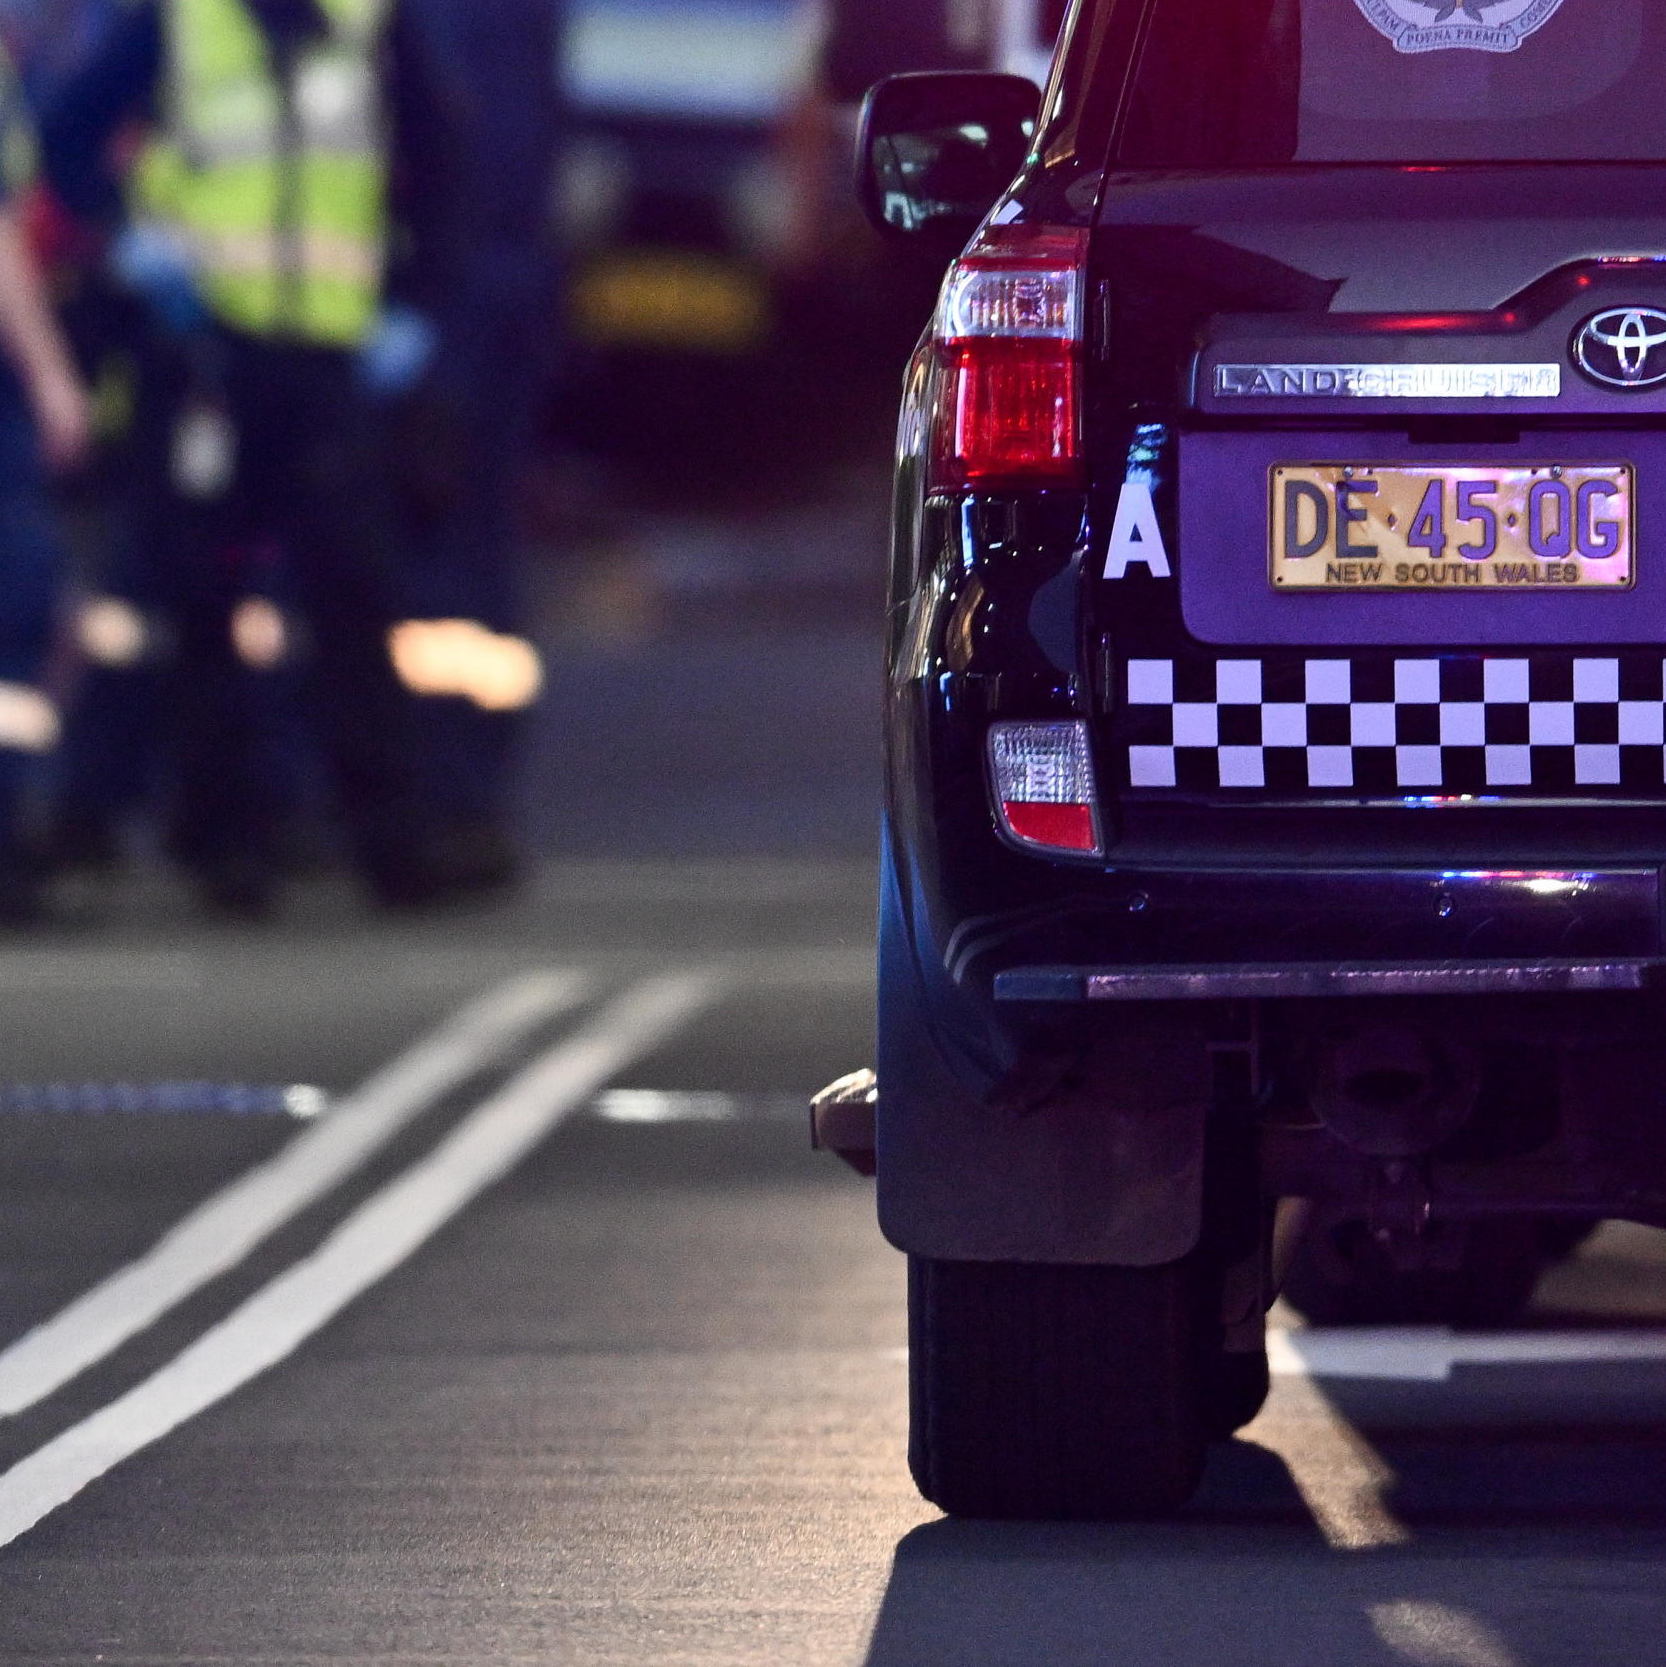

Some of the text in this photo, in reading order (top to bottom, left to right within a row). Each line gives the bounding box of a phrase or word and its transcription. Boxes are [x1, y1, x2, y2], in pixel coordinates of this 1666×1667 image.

[1222, 368, 1340, 395] LAND
[1103, 483, 1171, 579] A
[1326, 562, 1579, 583] NEW SOUTH WALES
